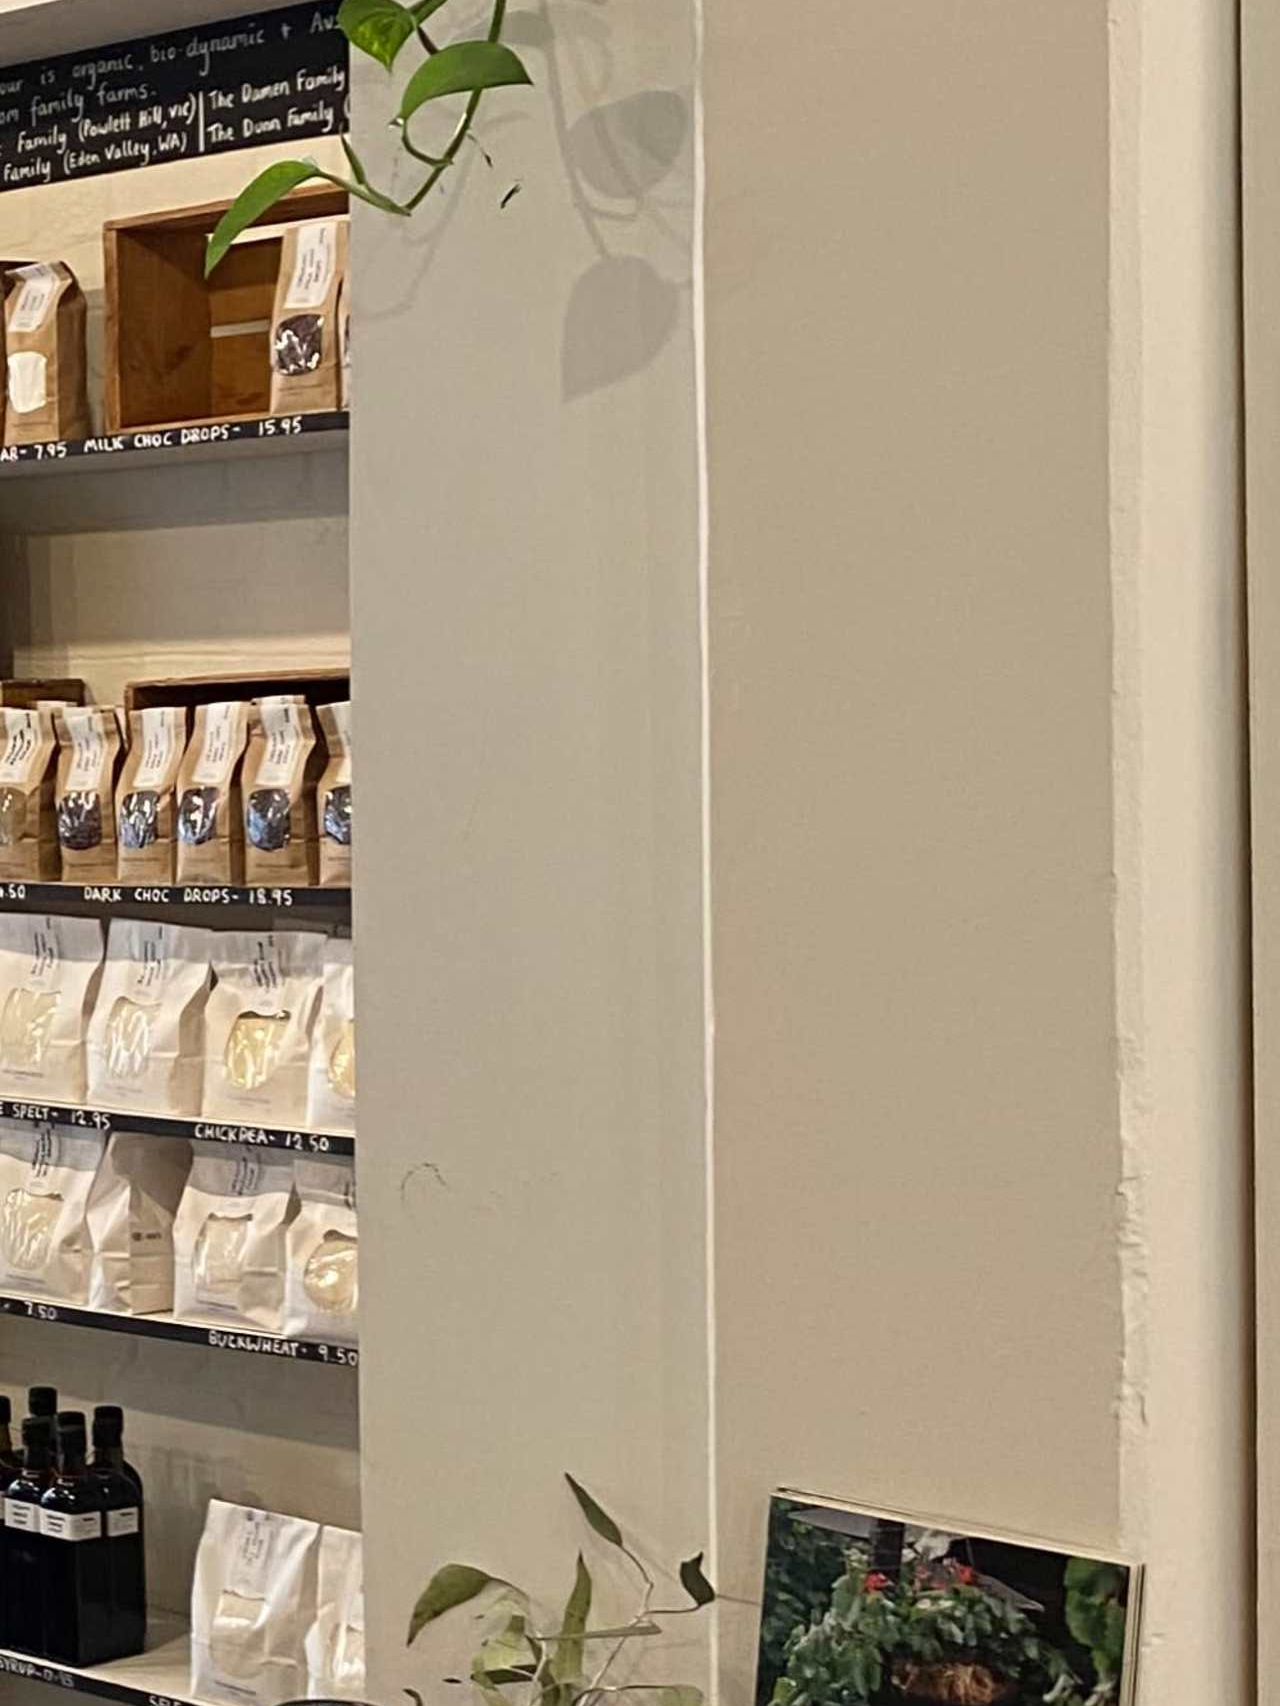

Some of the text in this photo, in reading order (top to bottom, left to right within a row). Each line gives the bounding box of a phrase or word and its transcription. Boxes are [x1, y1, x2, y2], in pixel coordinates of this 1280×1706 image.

[40, 66, 55, 84] is
[151, 22, 264, 76] bio-dynamic
[30, 88, 84, 127] family
[208, 63, 346, 111] The Damen Family
[17, 124, 67, 154] Family
[77, 110, 131, 141] (Powlett
[206, 99, 335, 144] The Dunn Family
[3, 156, 52, 183] Family
[63, 149, 101, 175] (Eden
[157, 130, 188, 154] WA)
[83, 435, 124, 453] MILK
[133, 431, 173, 448] CHOC
[84, 886, 122, 902] DARK
[133, 888, 170, 903] CHOC
